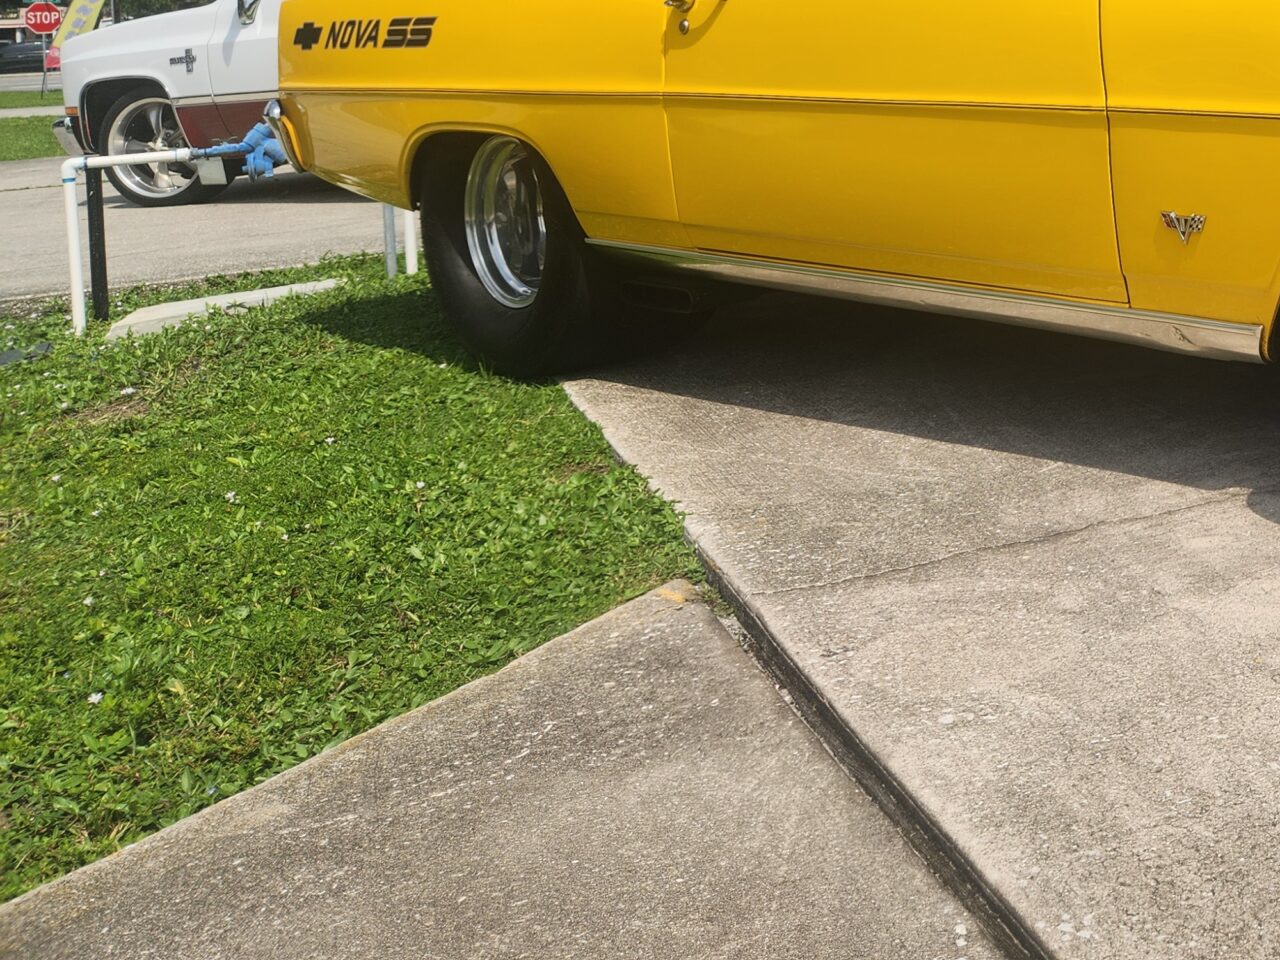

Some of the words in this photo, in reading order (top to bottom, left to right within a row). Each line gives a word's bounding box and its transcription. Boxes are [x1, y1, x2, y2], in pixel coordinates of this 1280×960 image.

[27, 11, 60, 24] STOP
[324, 19, 381, 49] NOVA
[382, 16, 438, 48] SS
